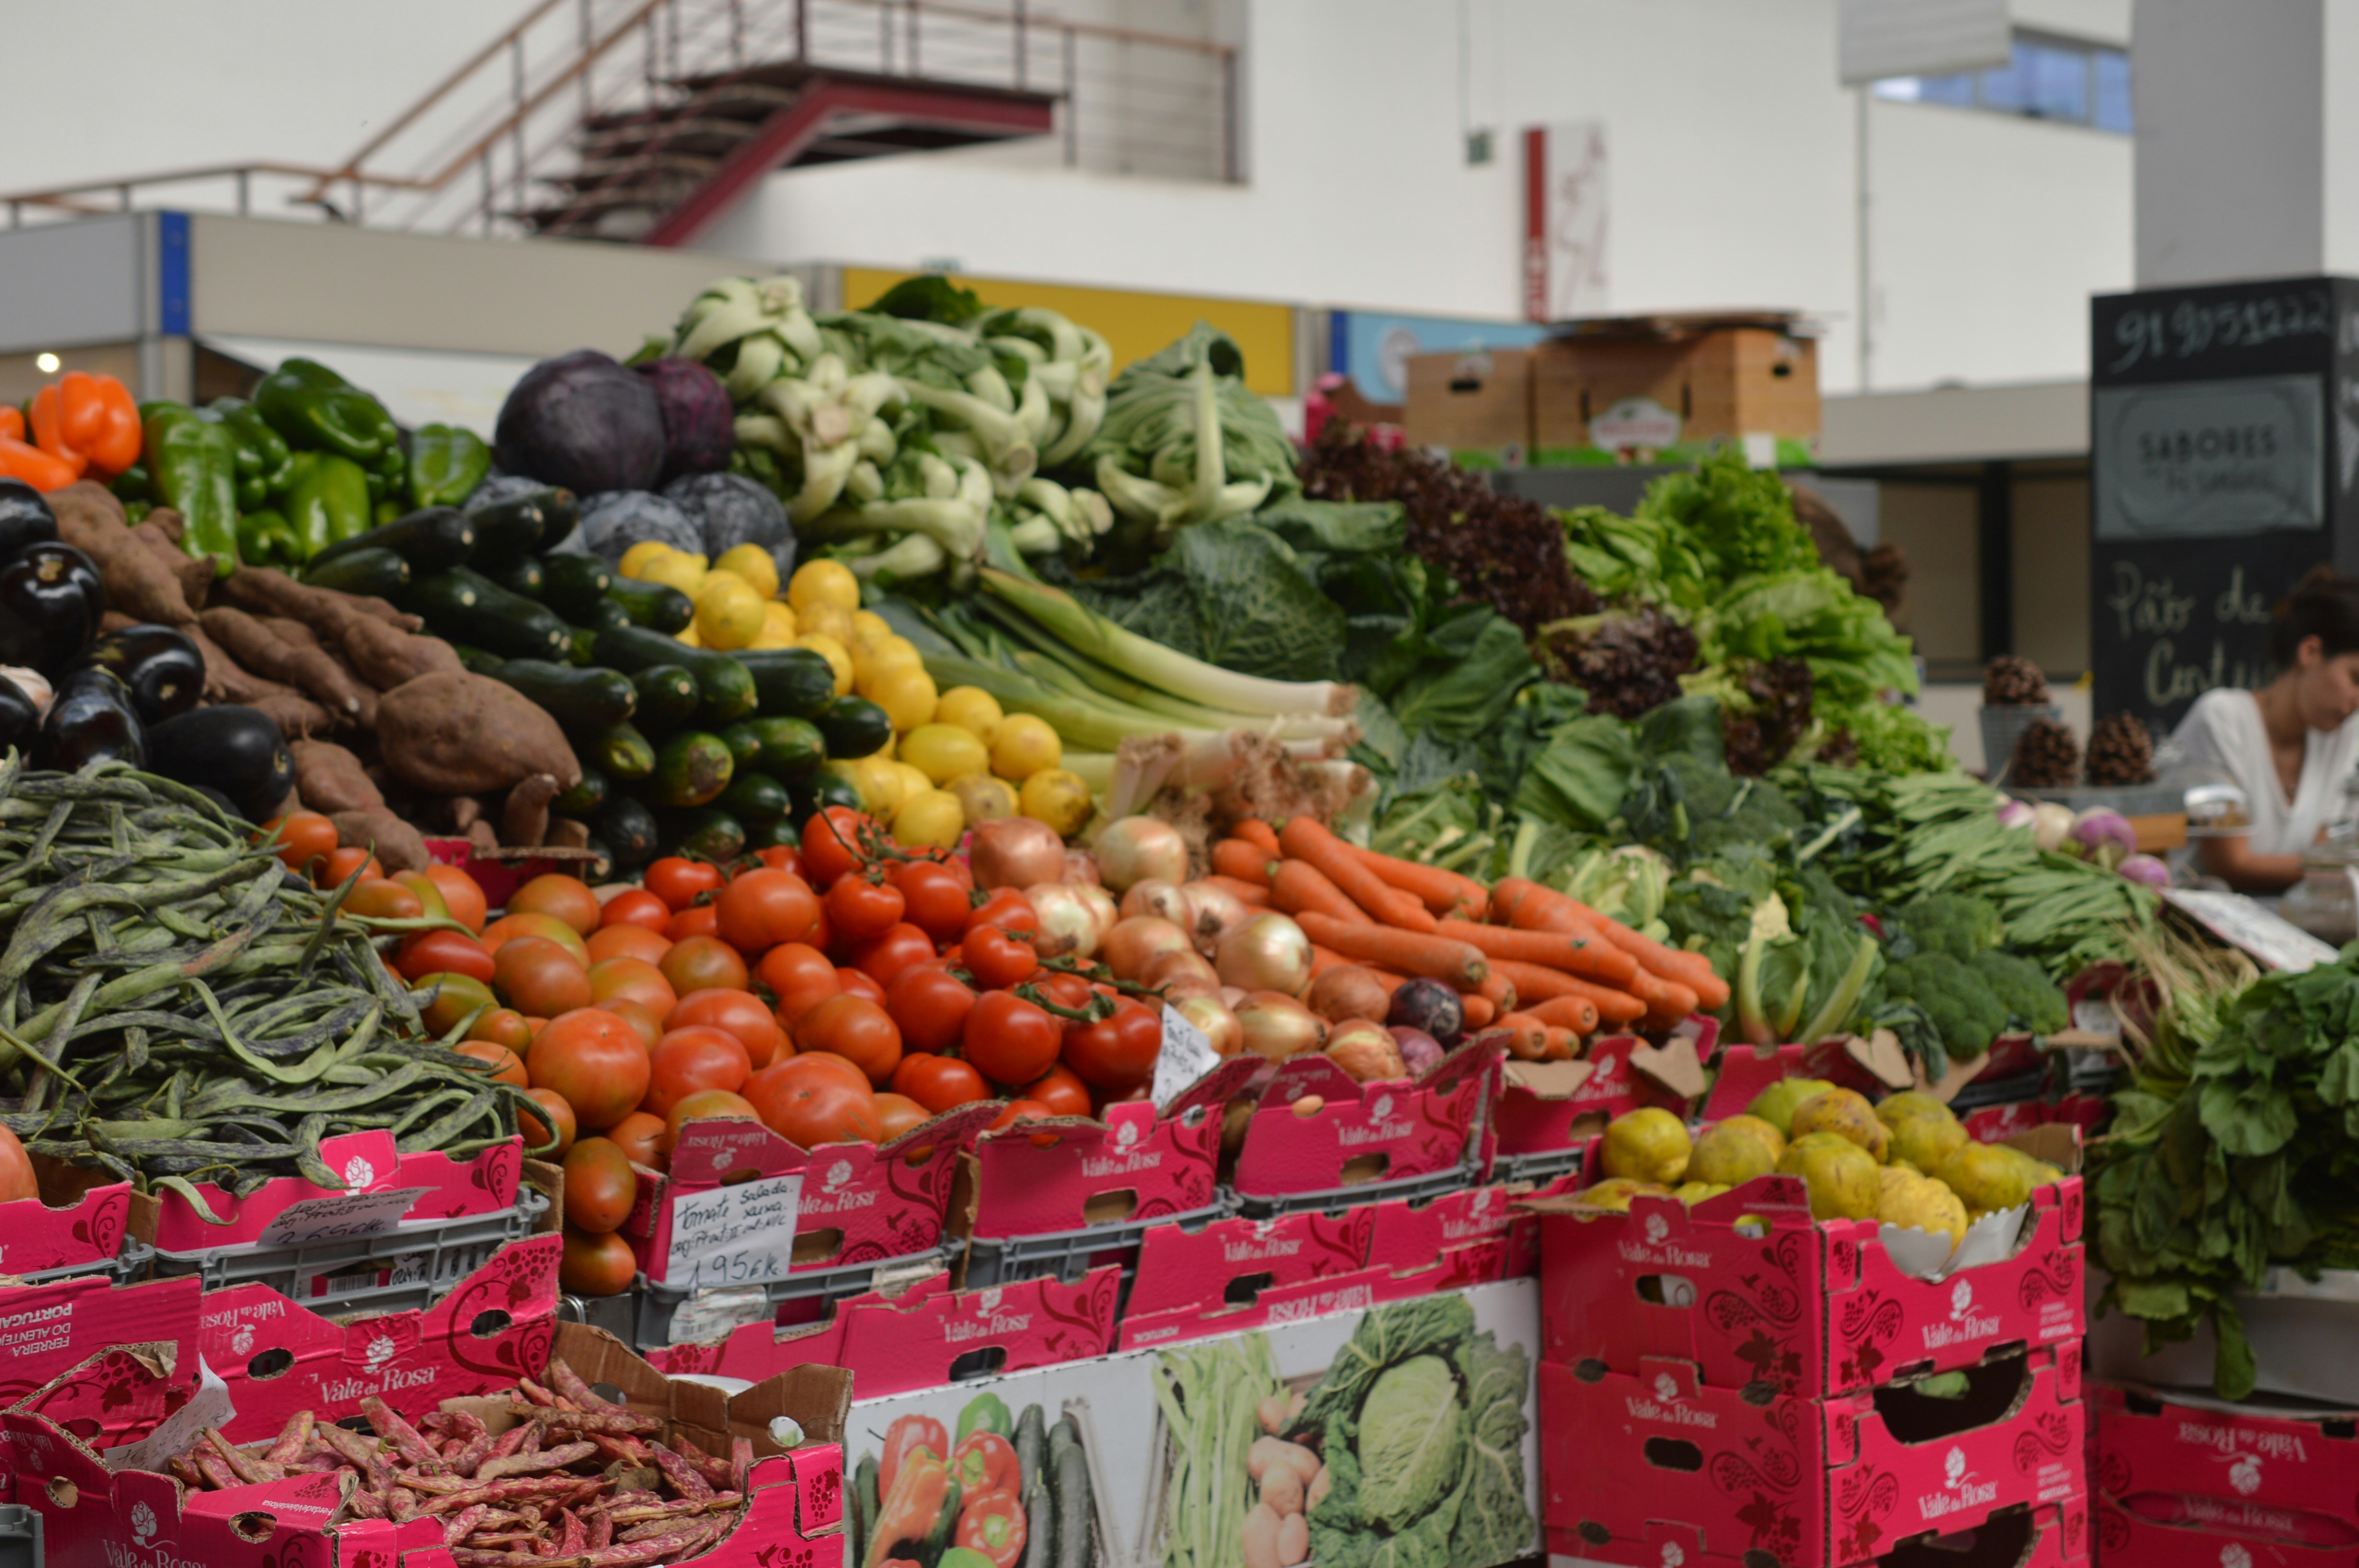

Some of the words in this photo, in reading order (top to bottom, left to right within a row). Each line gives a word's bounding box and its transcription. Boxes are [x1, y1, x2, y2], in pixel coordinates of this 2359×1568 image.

[798, 1194, 822, 1215] ale
[241, 1306, 252, 1316] da
[253, 1300, 285, 1321] Vale
[1265, 1295, 1318, 1325] Rosa
[1333, 1284, 1373, 1311] Vale
[0, 1303, 73, 1330] PORTUGA
[52, 1322, 71, 1336] DO
[200, 1308, 238, 1329] Rosa
[944, 1319, 978, 1343] Vale
[989, 1313, 1029, 1336] Rosa
[13, 1336, 70, 1357] FERREIRA
[1922, 1321, 1953, 1350] Vale
[1964, 1315, 1999, 1341] Rosa
[321, 1377, 364, 1404] Vale
[364, 1382, 379, 1396] da
[382, 1366, 435, 1392] Rosa
[2179, 1422, 2236, 1453] Rosa
[2257, 1431, 2307, 1462] Vale
[1918, 1491, 1950, 1520] Vale
[1961, 1480, 1997, 1509] Rosa
[102, 1539, 137, 1568] Vale
[155, 1549, 201, 1568] Rosa
